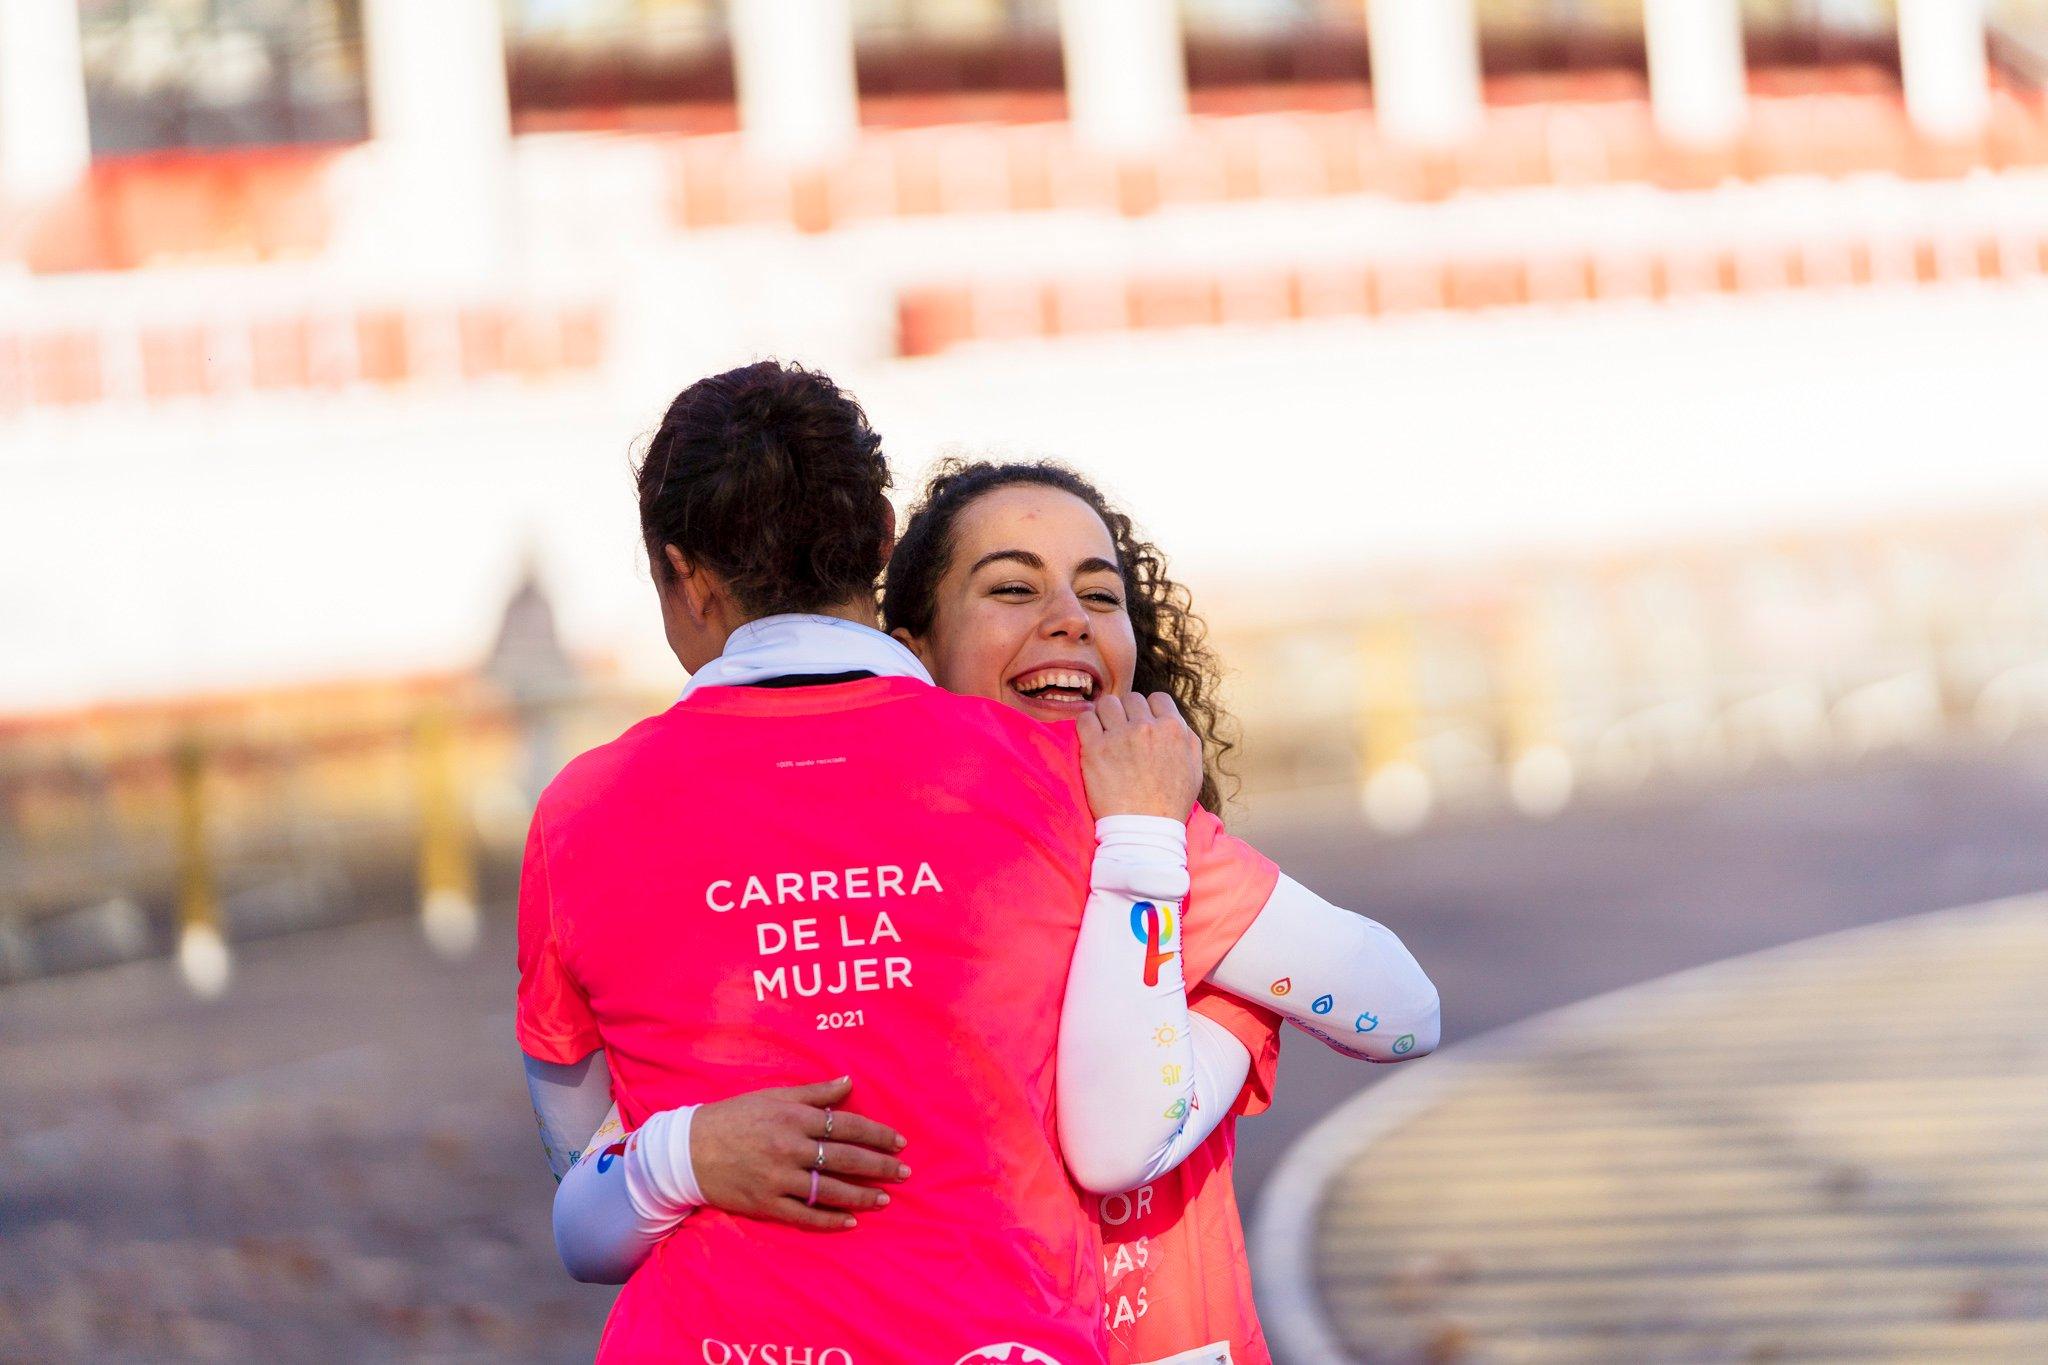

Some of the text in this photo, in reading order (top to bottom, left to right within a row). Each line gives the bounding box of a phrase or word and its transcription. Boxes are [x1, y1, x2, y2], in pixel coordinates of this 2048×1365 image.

[706, 862, 944, 912] CARRERA
[756, 911, 902, 956] DE LA
[753, 956, 913, 1001] MUJER
[816, 1009, 864, 1030] 2021
[1103, 1236, 1149, 1277] AS
[701, 1338, 853, 1365] OYSHO
